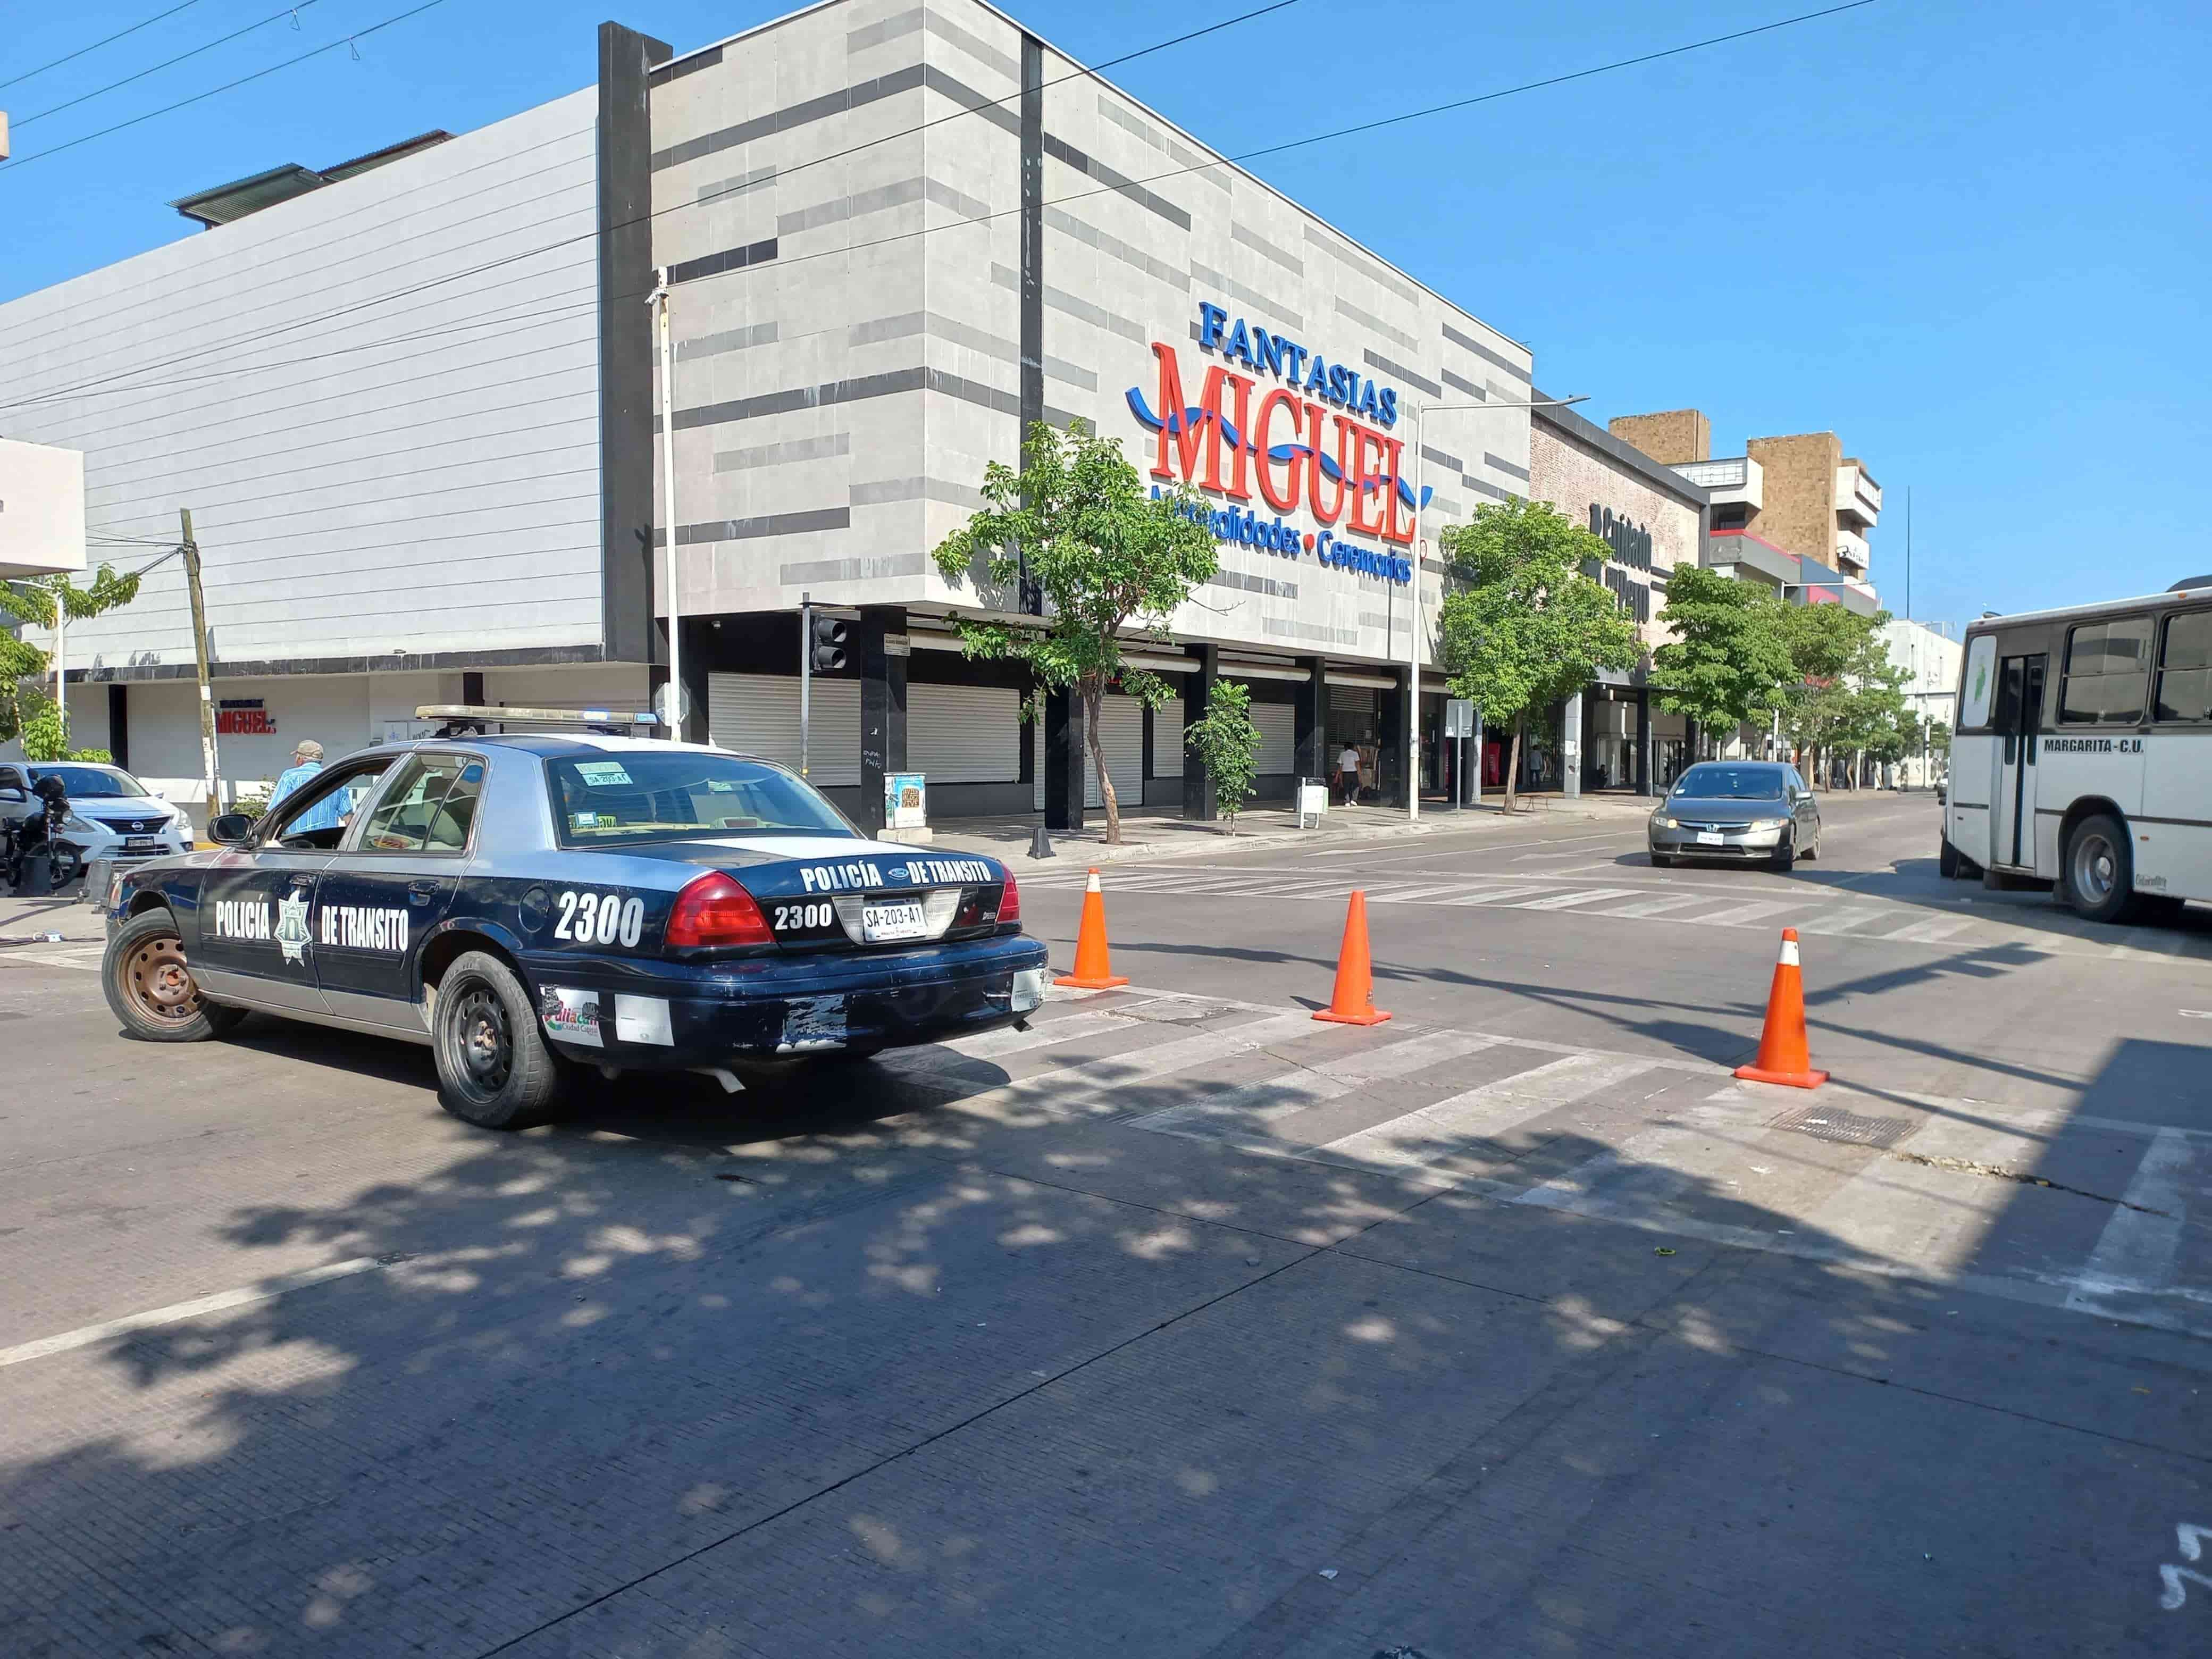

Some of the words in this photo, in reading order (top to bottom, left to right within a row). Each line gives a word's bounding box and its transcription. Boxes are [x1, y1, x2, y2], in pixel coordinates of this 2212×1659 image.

[1198, 301, 1397, 426] FANTASIAS
[1149, 342, 1415, 544] MIGUEL
[1317, 530, 1411, 582] Ceremonias
[2044, 739, 2112, 752] MARGARITA
[2119, 740, 2144, 753] C.U.
[800, 860, 883, 892] POLICÍA
[906, 861, 929, 884] DE
[928, 860, 992, 883] TRANSITO
[215, 894, 270, 940] POLICÍA
[321, 905, 338, 944] DE
[339, 907, 409, 952] TRANSITO
[554, 891, 644, 948] 2300
[774, 903, 832, 931] 2300
[866, 906, 921, 927] SA-203-A1
